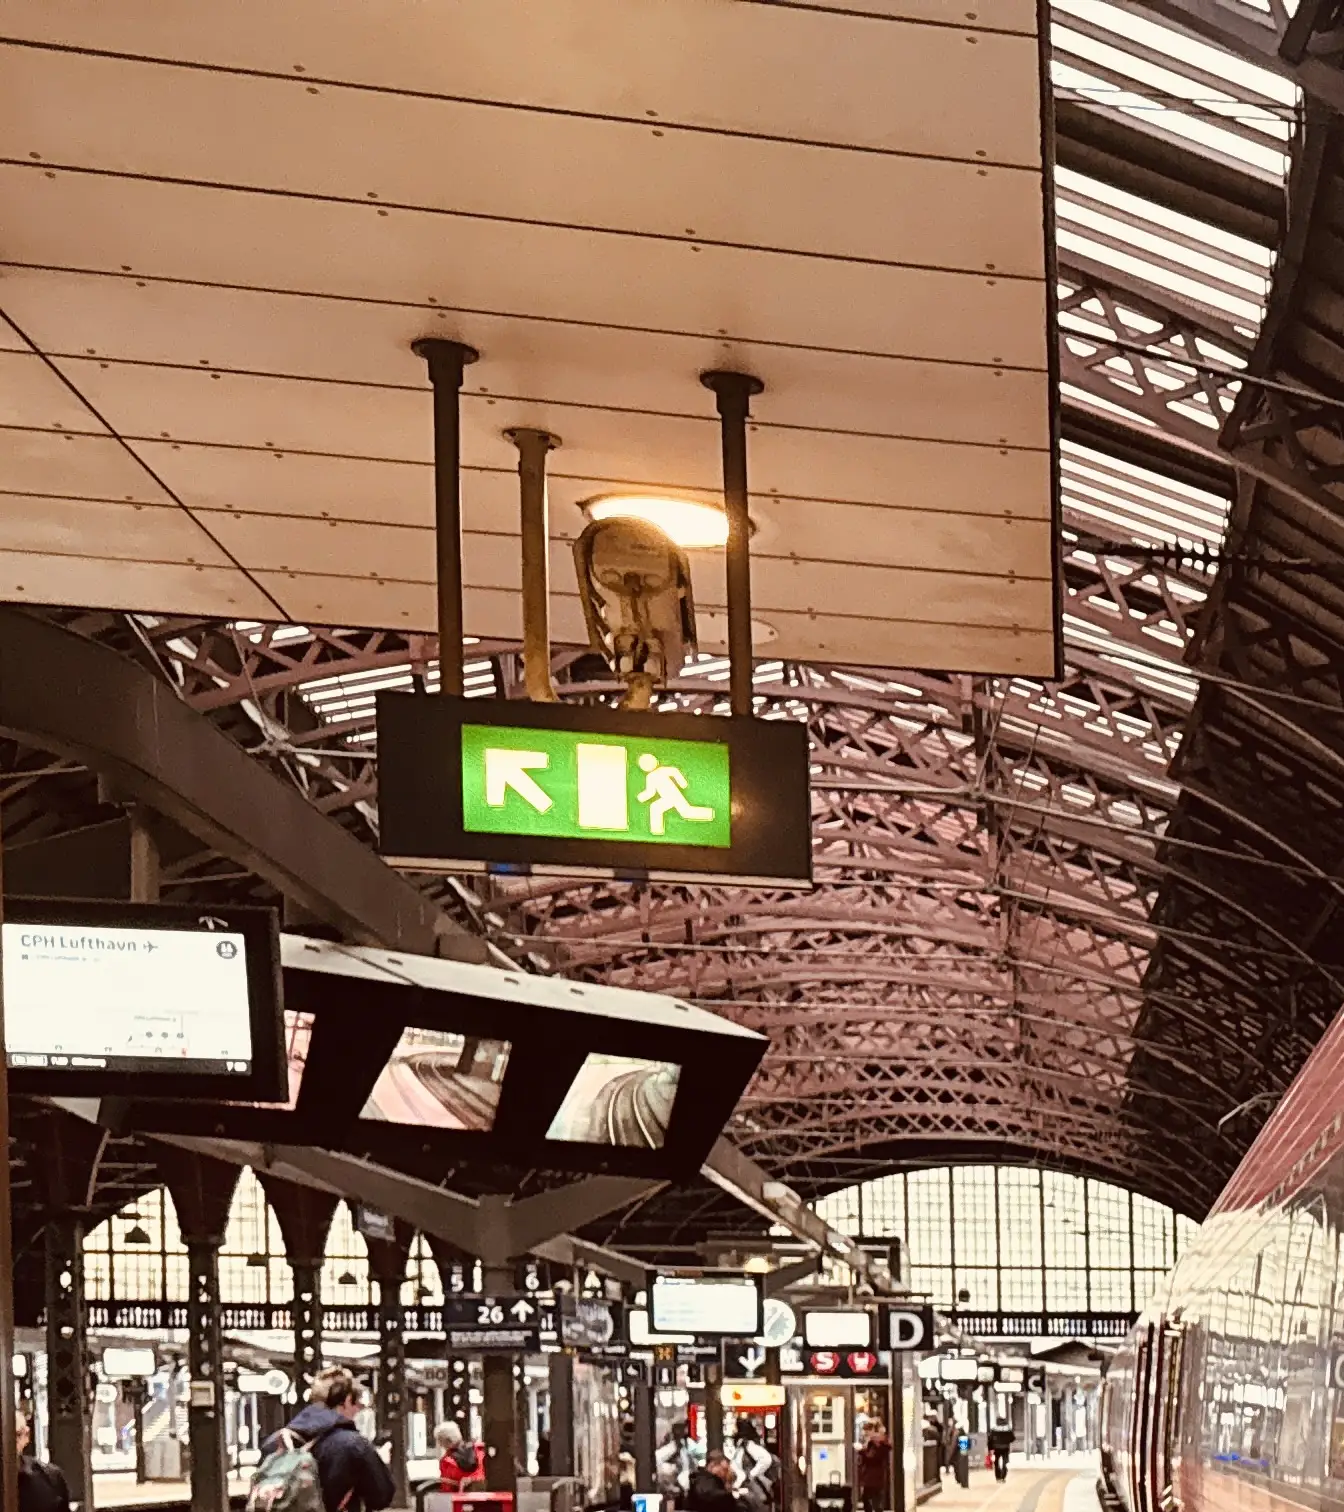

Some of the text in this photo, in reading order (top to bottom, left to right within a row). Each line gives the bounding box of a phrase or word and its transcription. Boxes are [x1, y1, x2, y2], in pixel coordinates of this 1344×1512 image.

[21, 934, 137, 952] CPH Lufthavn
[451, 1273, 464, 1293] 5
[525, 1271, 540, 1290] 6
[477, 1305, 504, 1325] 26
[889, 1311, 925, 1350] D
